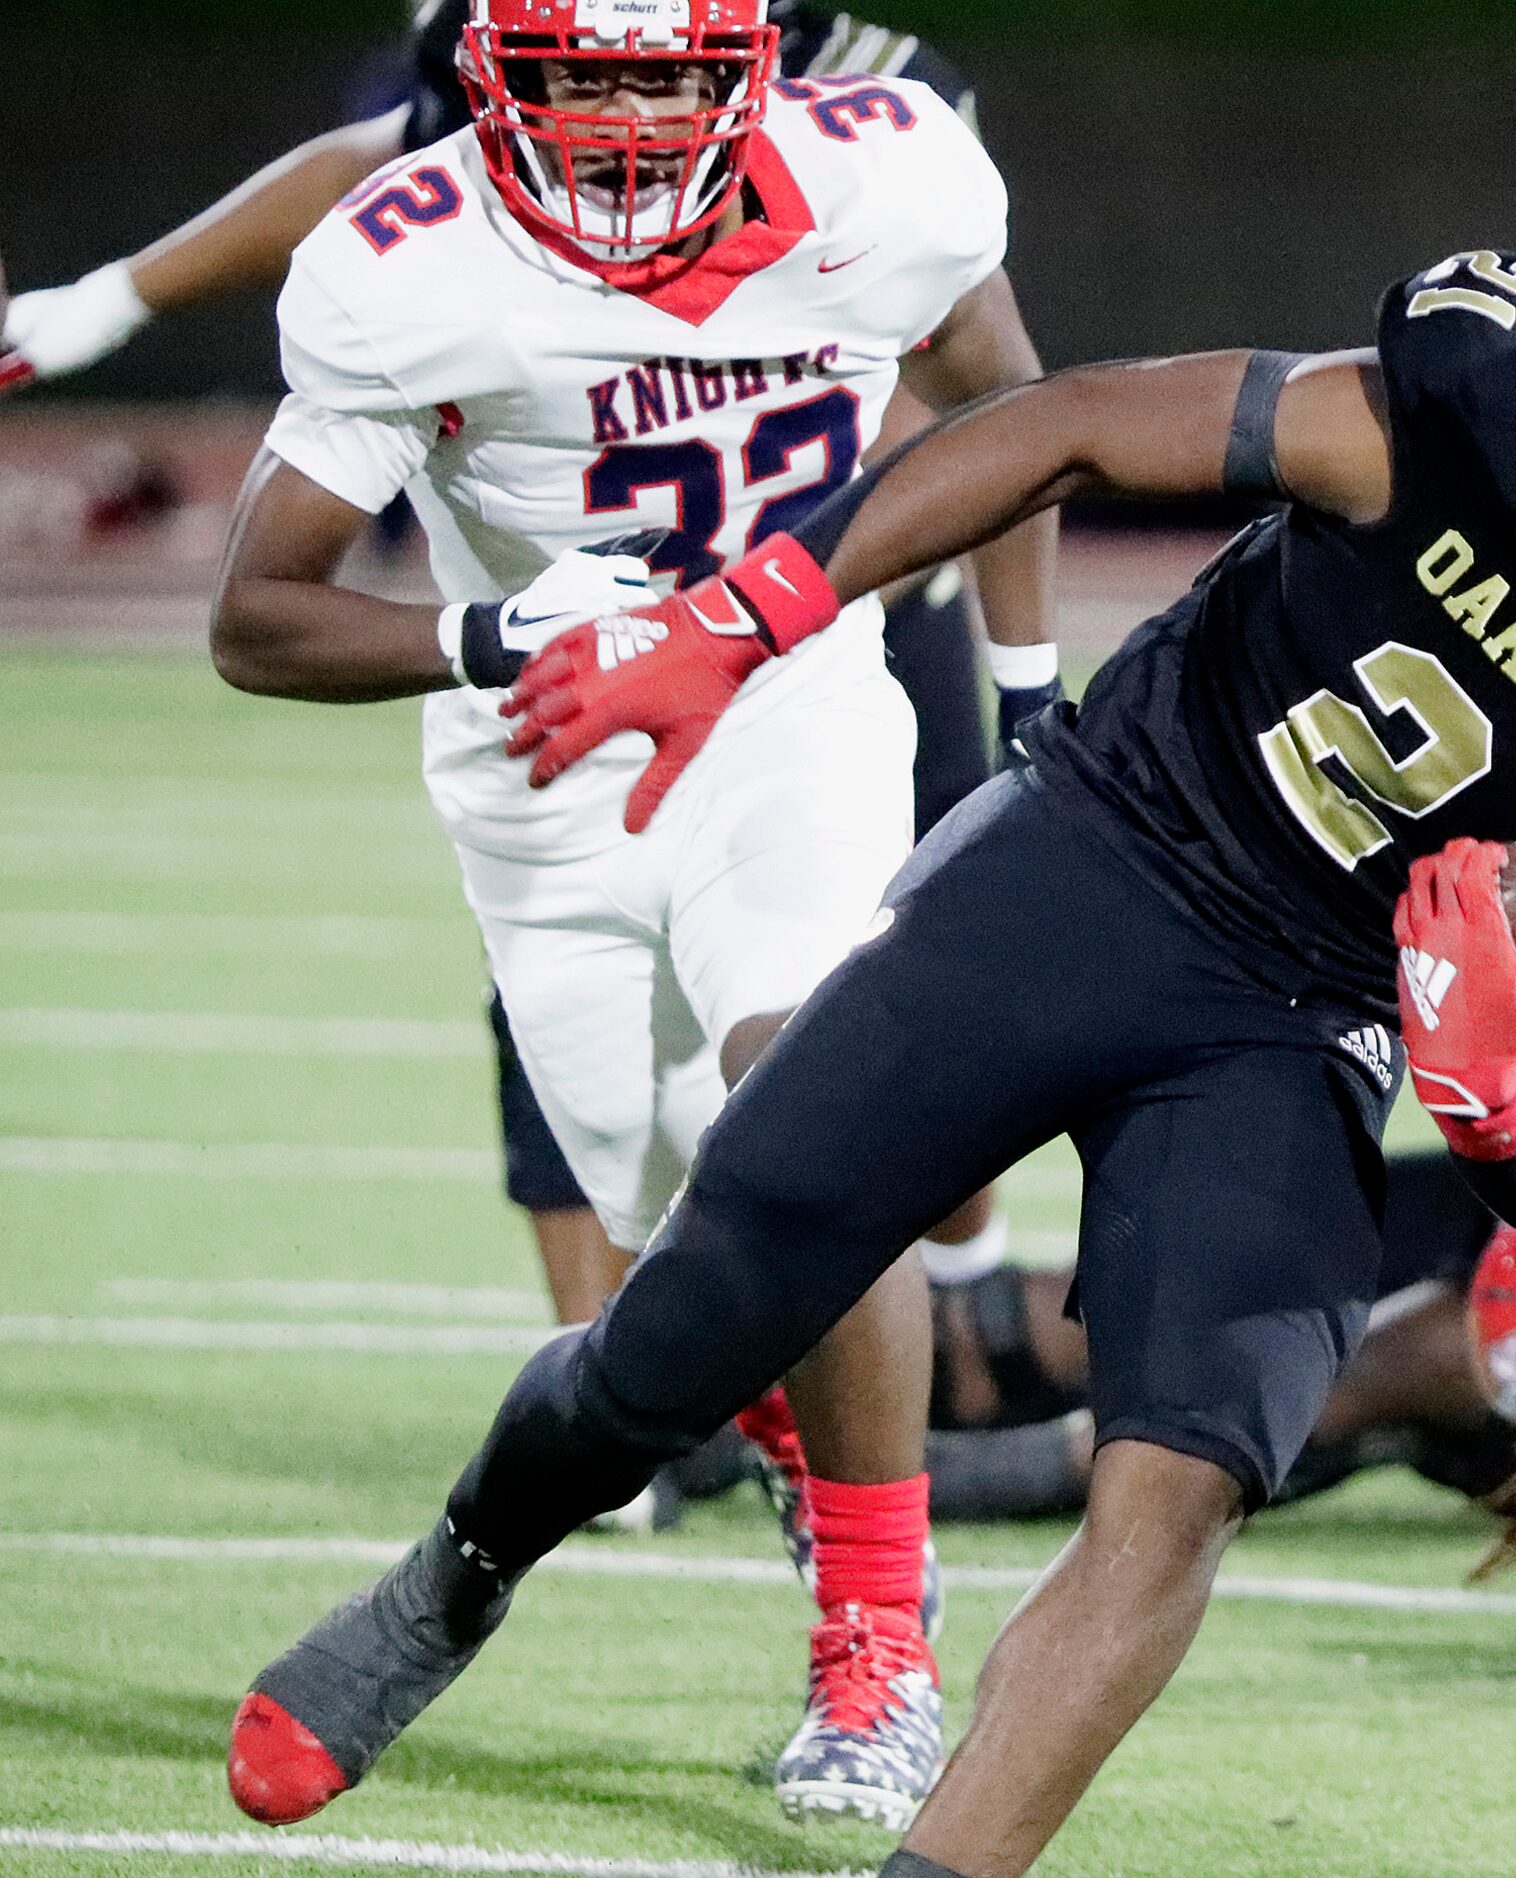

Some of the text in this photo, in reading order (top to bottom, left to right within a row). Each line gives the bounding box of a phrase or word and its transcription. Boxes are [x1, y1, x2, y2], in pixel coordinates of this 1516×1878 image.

[613, 1, 658, 14] schutt
[334, 160, 464, 257] 2
[1338, 1036, 1393, 1090] adidas
